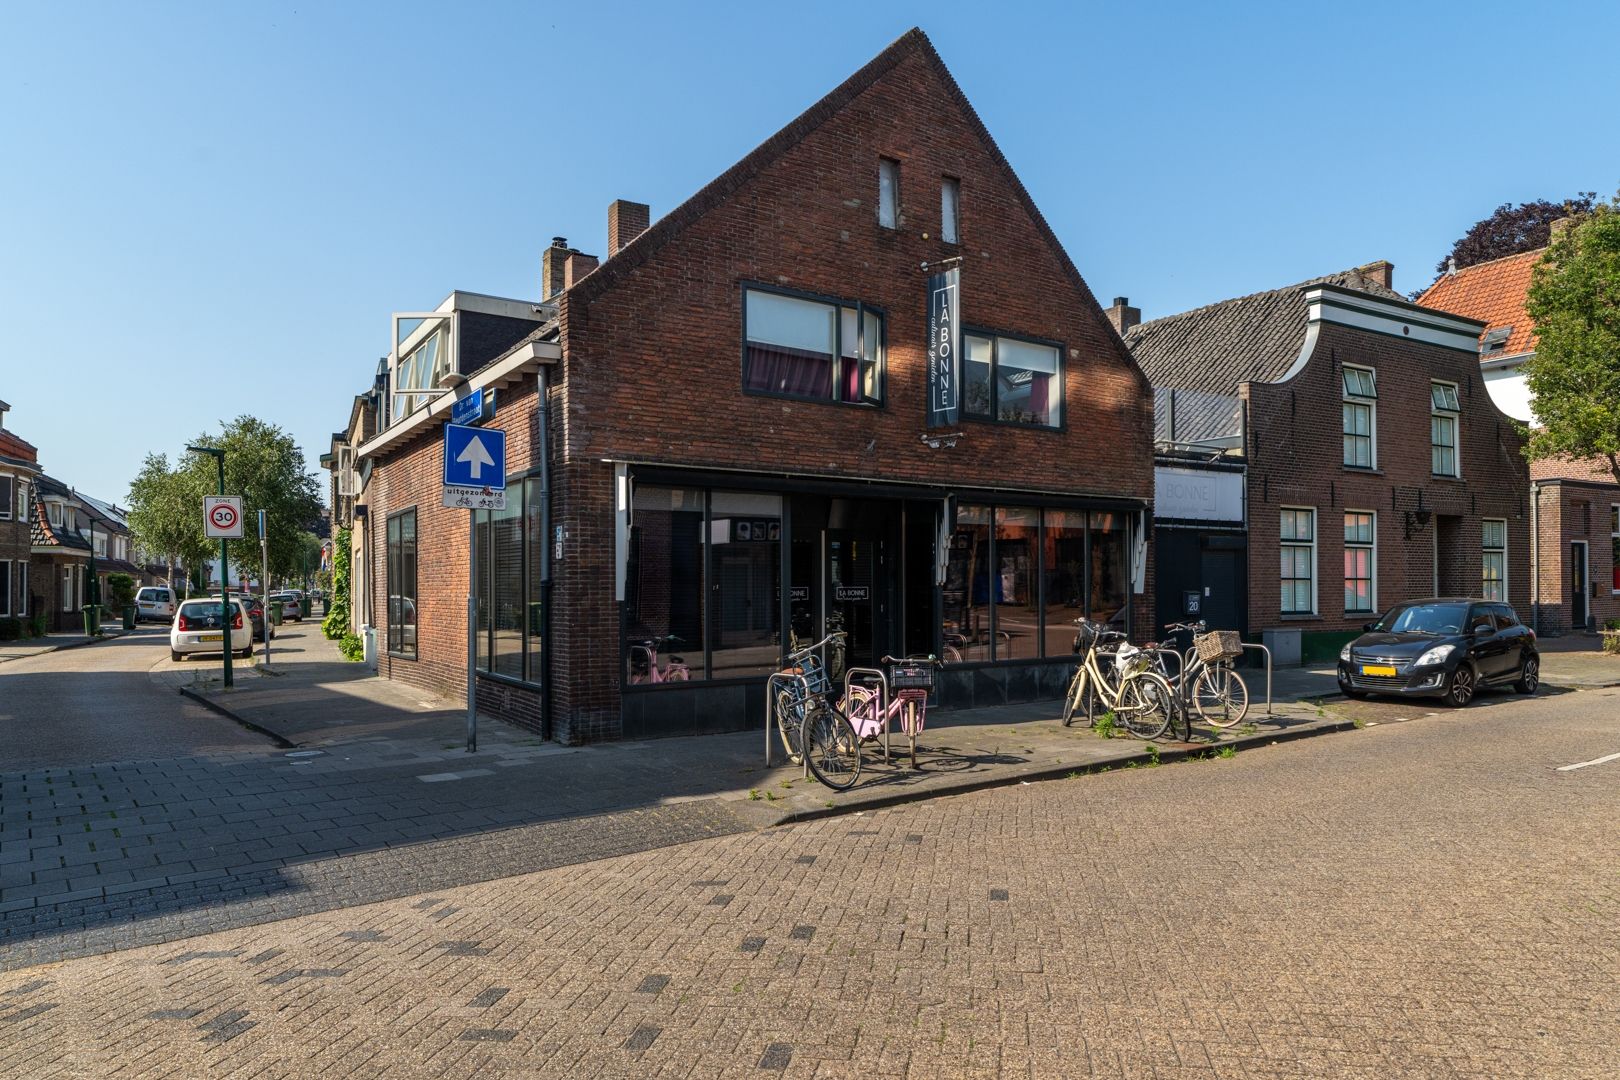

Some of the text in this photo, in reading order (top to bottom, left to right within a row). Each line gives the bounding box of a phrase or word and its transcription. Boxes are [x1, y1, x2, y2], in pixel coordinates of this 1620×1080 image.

[939, 293, 949, 405] LA BONNE
[447, 488, 503, 497] uitgezonrd
[1166, 484, 1209, 501] BONNE
[216, 513, 232, 522] 30
[1189, 601, 1199, 611] 20
